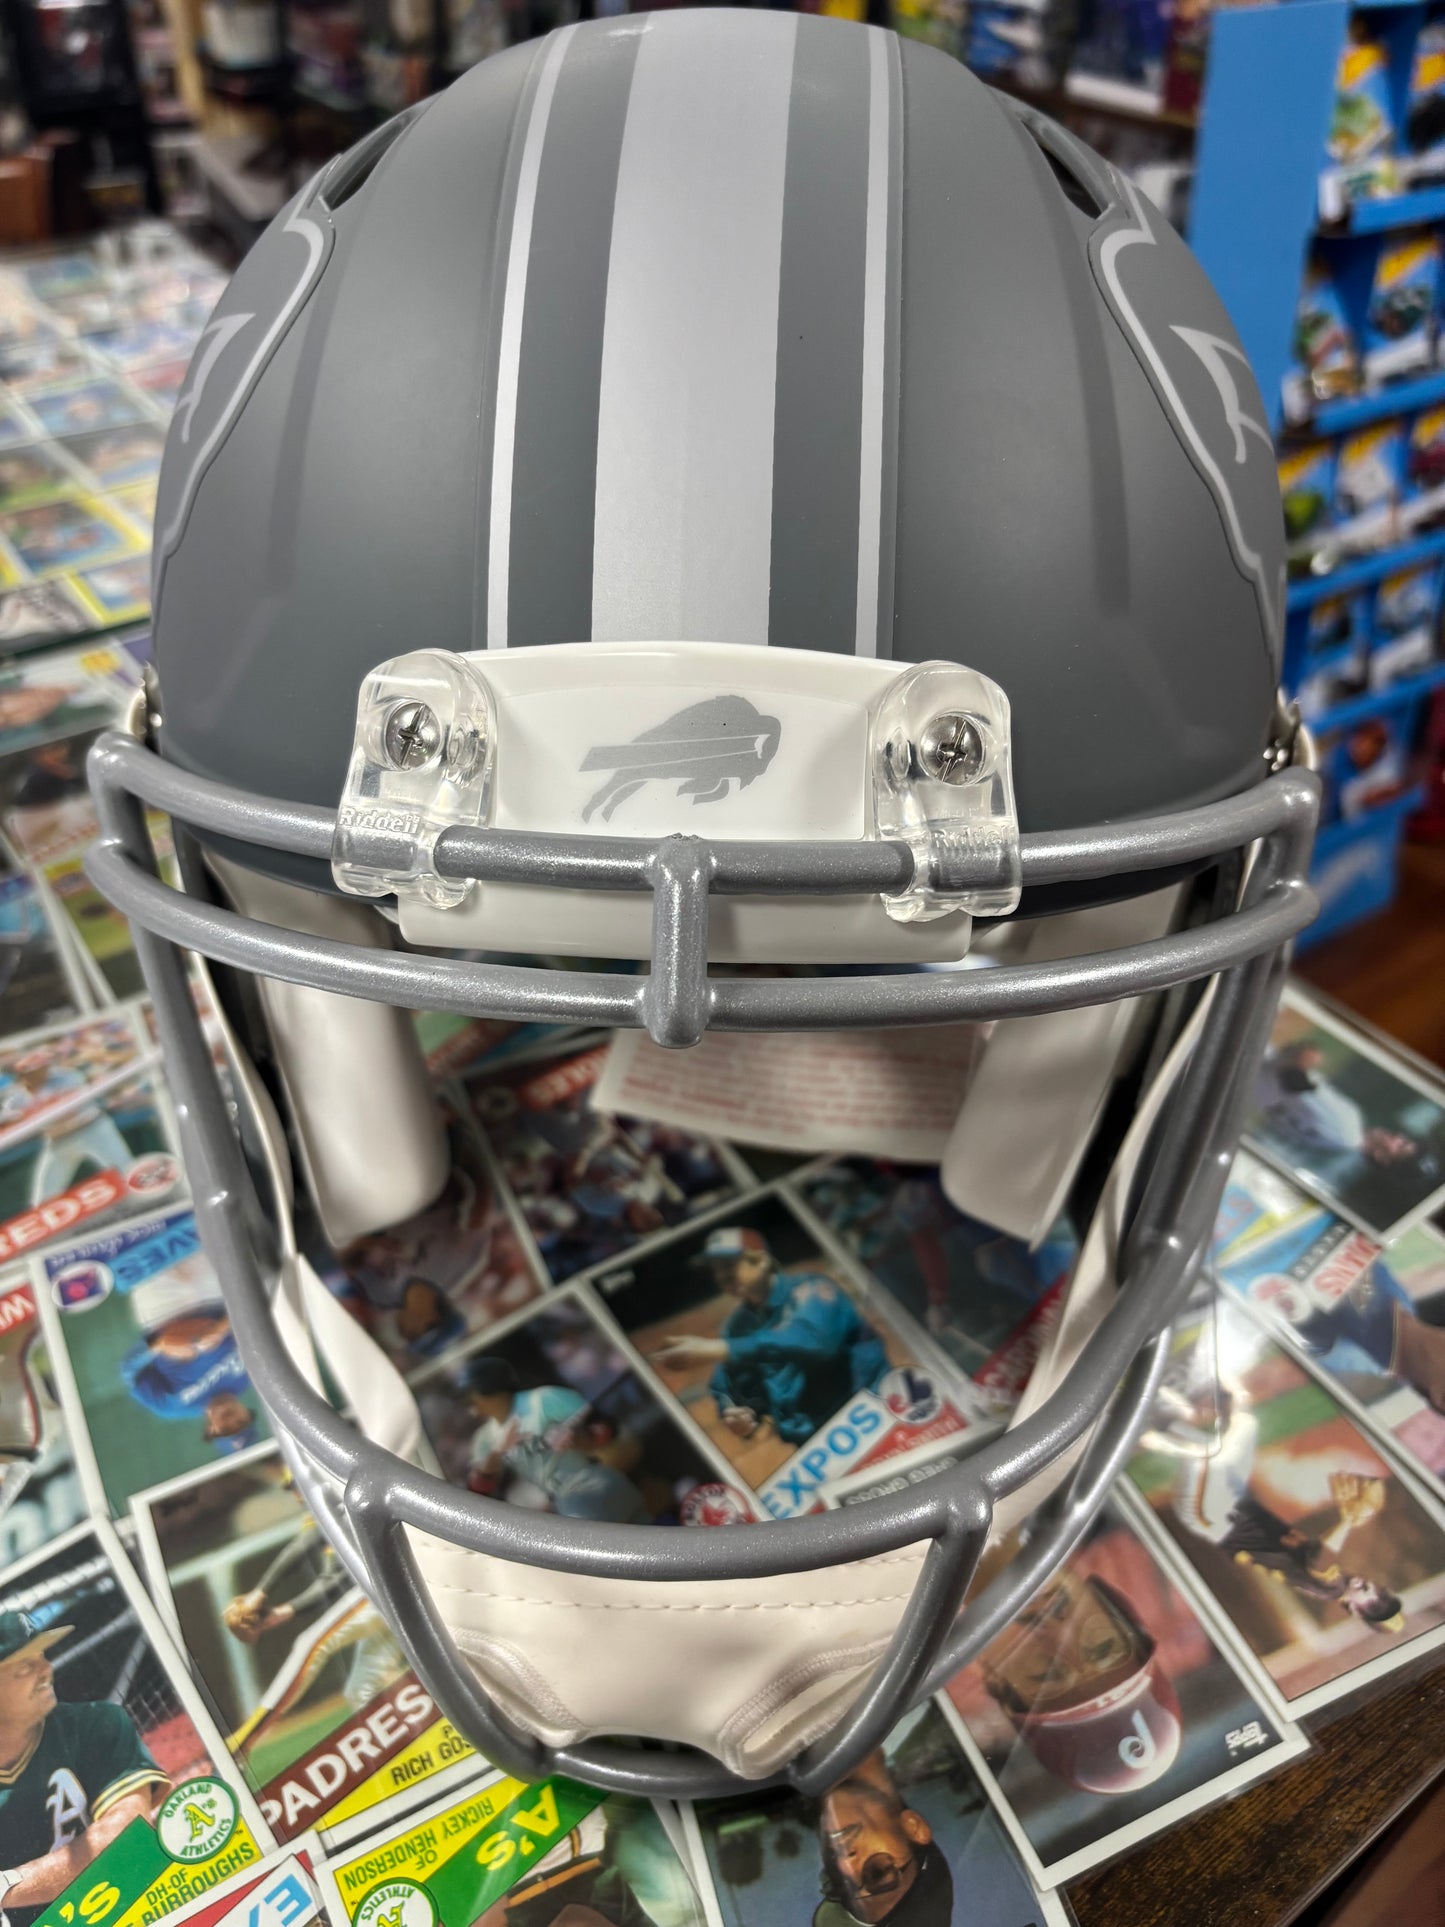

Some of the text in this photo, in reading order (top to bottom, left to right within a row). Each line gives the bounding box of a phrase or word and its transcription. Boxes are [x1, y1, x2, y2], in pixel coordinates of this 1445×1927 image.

[760, 1402, 882, 1520] EXPOS
[259, 1683, 434, 1827] PADRES
[390, 1750, 435, 1786] RICH
[164, 1783, 213, 1819] OAKLAND
[180, 1818, 232, 1857] ATHLETICS
[343, 1797, 495, 1891] RICKEY HENDERSON
[476, 1785, 560, 1871] A'S
[415, 1850, 438, 1871] OF
[141, 1841, 255, 1927] BURROUGHS
[146, 1867, 188, 1907] DH-OF
[361, 1885, 417, 1921] ATHLETICS
